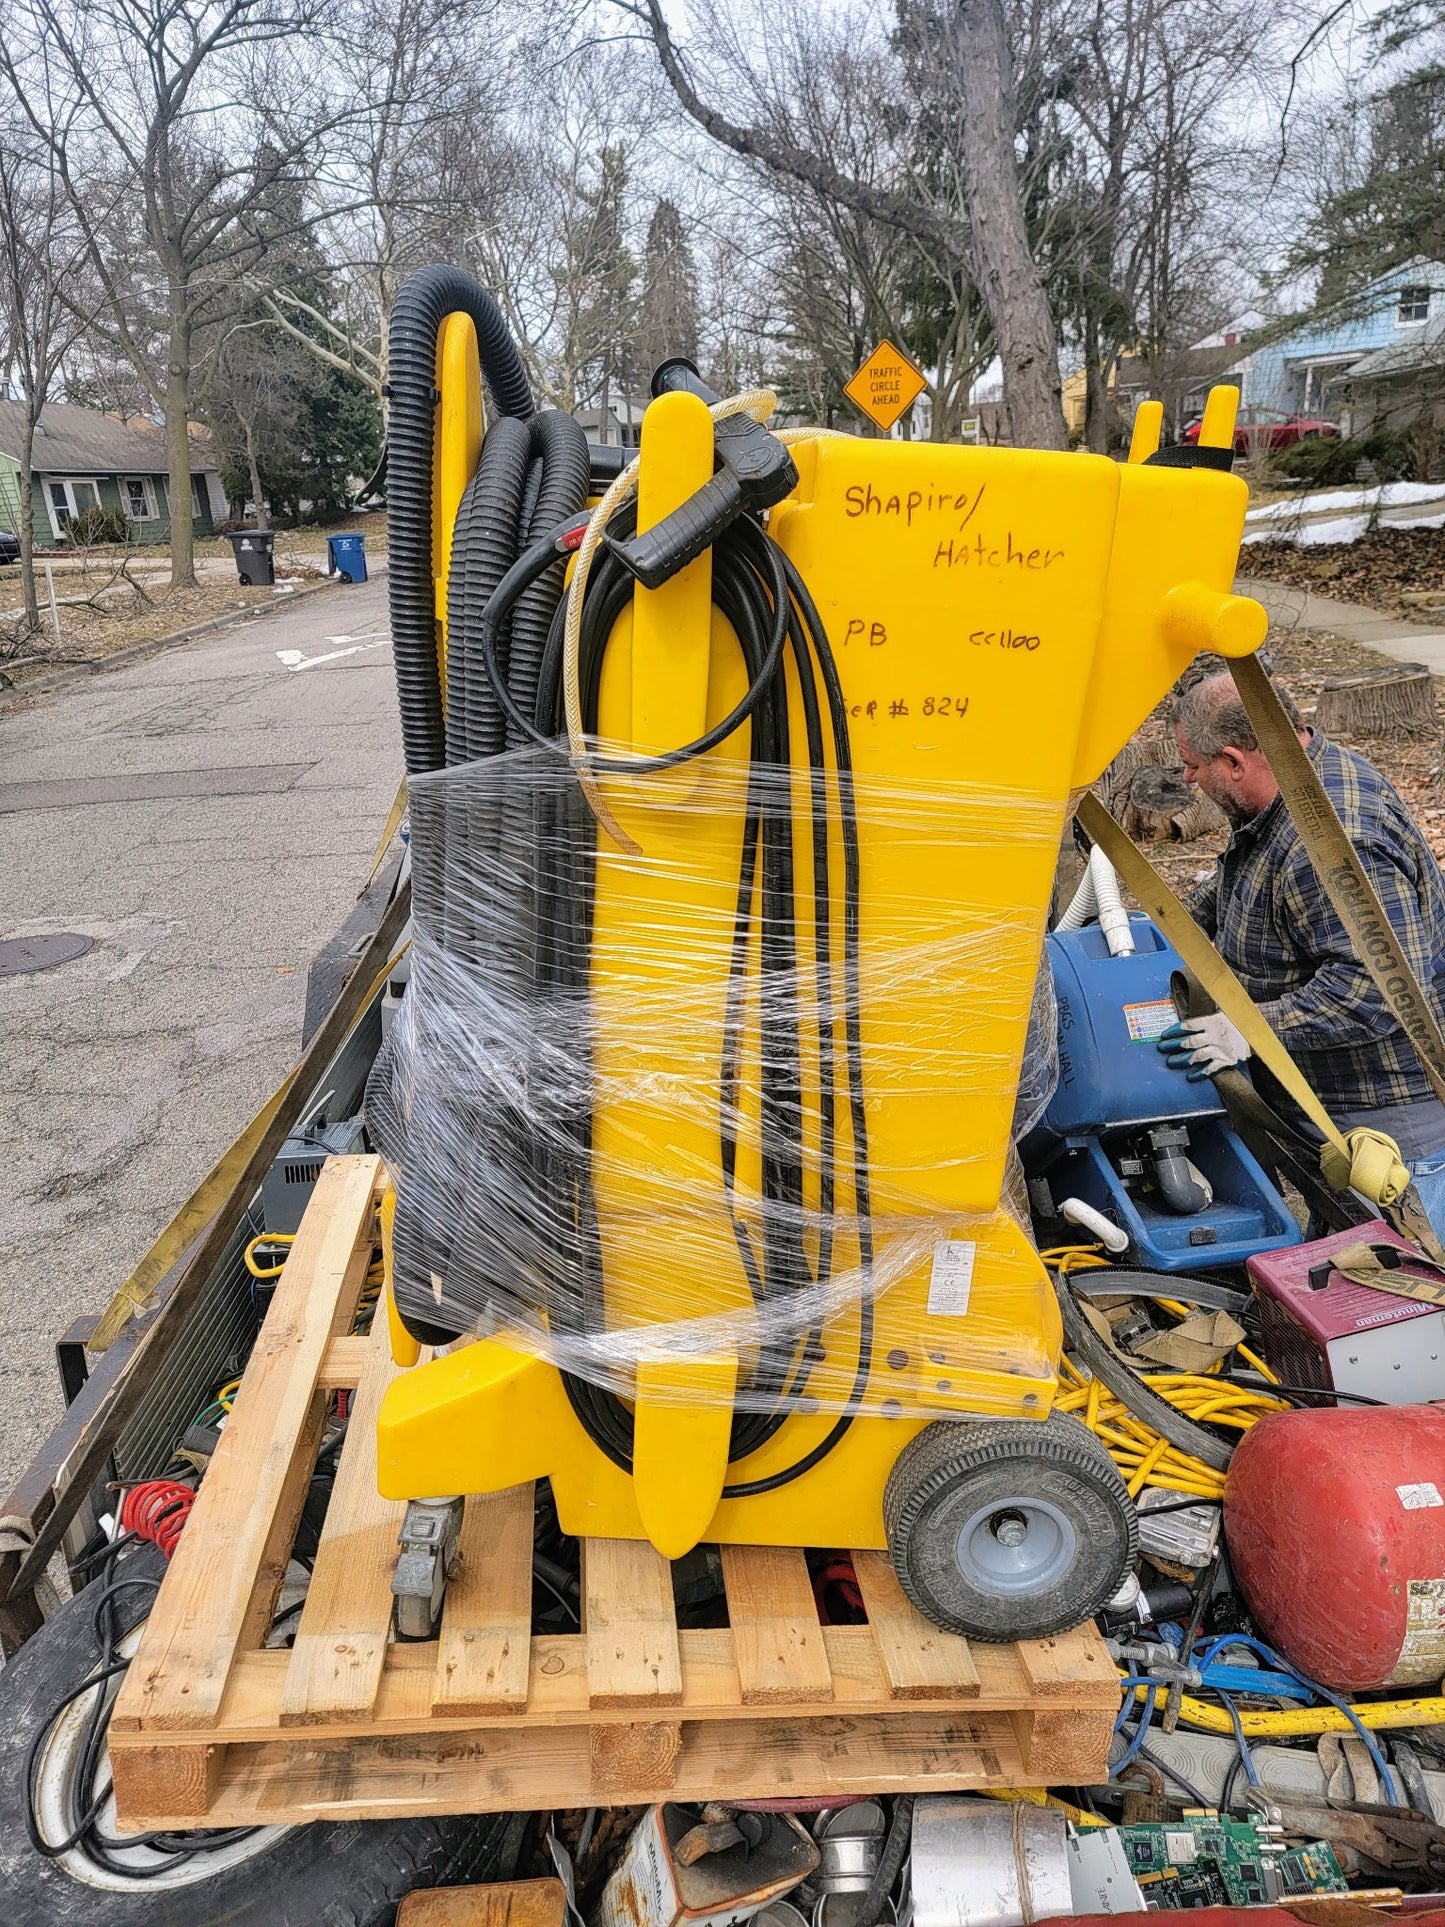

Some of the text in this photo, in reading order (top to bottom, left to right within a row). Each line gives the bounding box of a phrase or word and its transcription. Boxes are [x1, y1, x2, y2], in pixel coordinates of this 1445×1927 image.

[869, 367, 903, 379] TRAFFIC
[870, 380, 901, 392] CIRCLE
[872, 394, 901, 406] AHEAD
[844, 619, 888, 647] PB
[889, 699, 910, 719] #
[922, 697, 970, 718] 824
[1328, 857, 1398, 974] CONTROL
[1058, 996, 1075, 1030] PBGS
[1058, 1051, 1076, 1089] HALL
[1355, 1302, 1435, 1327] Minuteman
